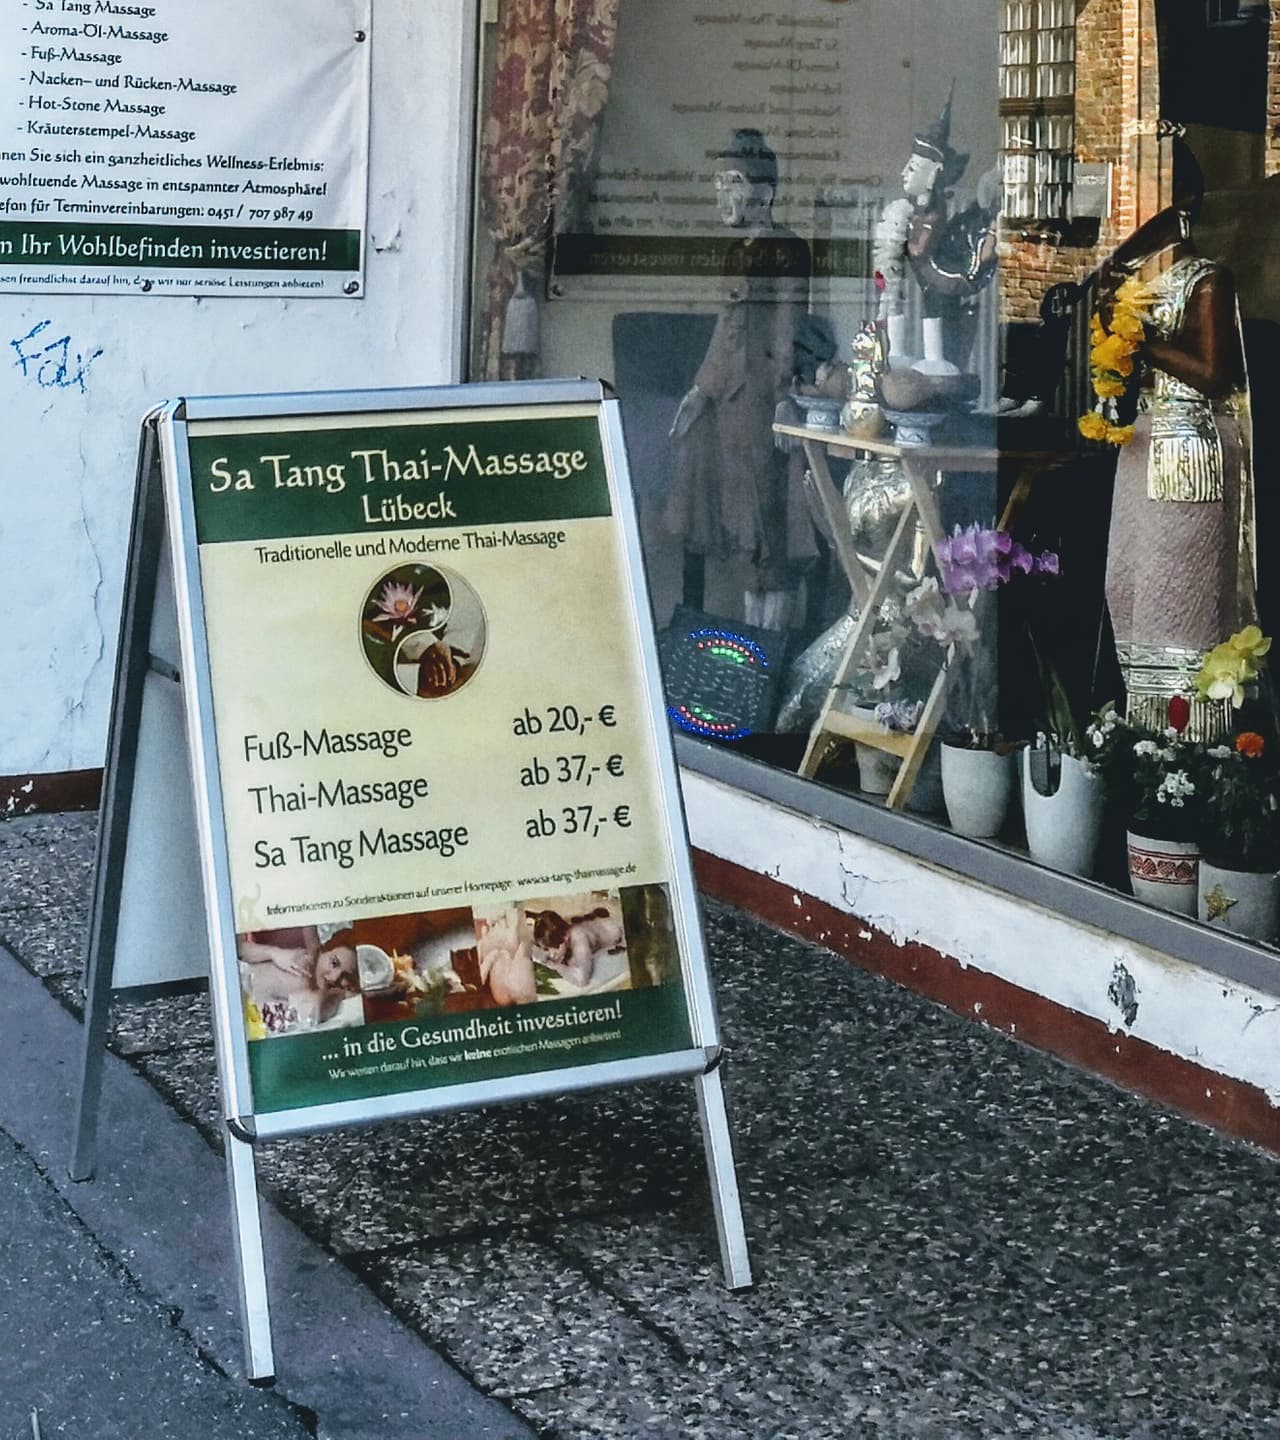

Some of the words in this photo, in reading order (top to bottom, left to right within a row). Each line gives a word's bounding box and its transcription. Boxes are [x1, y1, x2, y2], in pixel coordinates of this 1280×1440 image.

[94, 0, 157, 18] Massage
[30, 21, 169, 44] Aroma-Öl-Massage
[30, 46, 123, 66] Fuß-Massage
[95, 74, 120, 88] und
[123, 74, 238, 96] Rücken-Massage
[28, 95, 101, 112] Hot-Stone
[103, 98, 166, 117] Massage
[27, 120, 197, 143] Kräuterstempel-Massage
[29, 147, 52, 162] Sie
[54, 149, 81, 163] sich
[84, 150, 105, 164] ein
[108, 152, 202, 168] ganzheitliches
[207, 154, 325, 172] Wellness-Erlebnis:
[0, 172, 78, 188] wohltuende
[80, 174, 143, 193] Massage
[146, 177, 159, 191] in
[162, 179, 240, 195] entspannter
[30, 198, 51, 214] für
[53, 198, 204, 219] Terminvereinbarungen:
[248, 208, 271, 221] 707
[273, 206, 296, 222] 987
[297, 209, 314, 222] 49
[20, 233, 52, 257] Ihr
[58, 232, 204, 261] Wohlbefinden
[210, 237, 328, 262] investieren!
[209, 457, 255, 493] Sa
[260, 453, 346, 493] Tang
[350, 443, 588, 485] Thai-Massage
[361, 491, 457, 524] Lübeck
[254, 540, 353, 565] Traditionelle
[355, 537, 386, 558] und
[388, 535, 462, 556] Moderne
[464, 528, 567, 552] Thai-Massage
[243, 727, 413, 763] Fuß-Massage
[512, 709, 543, 737] ab
[248, 774, 430, 815] Thai-Massage
[519, 757, 550, 787] ab
[254, 840, 287, 869] Sa
[291, 835, 354, 868] Tang
[359, 822, 470, 858] Massage
[525, 809, 556, 839] ab
[343, 1036, 363, 1058] in
[367, 1031, 397, 1054] die
[400, 1016, 514, 1049] Gesundheit
[516, 1000, 623, 1033] investieren!
